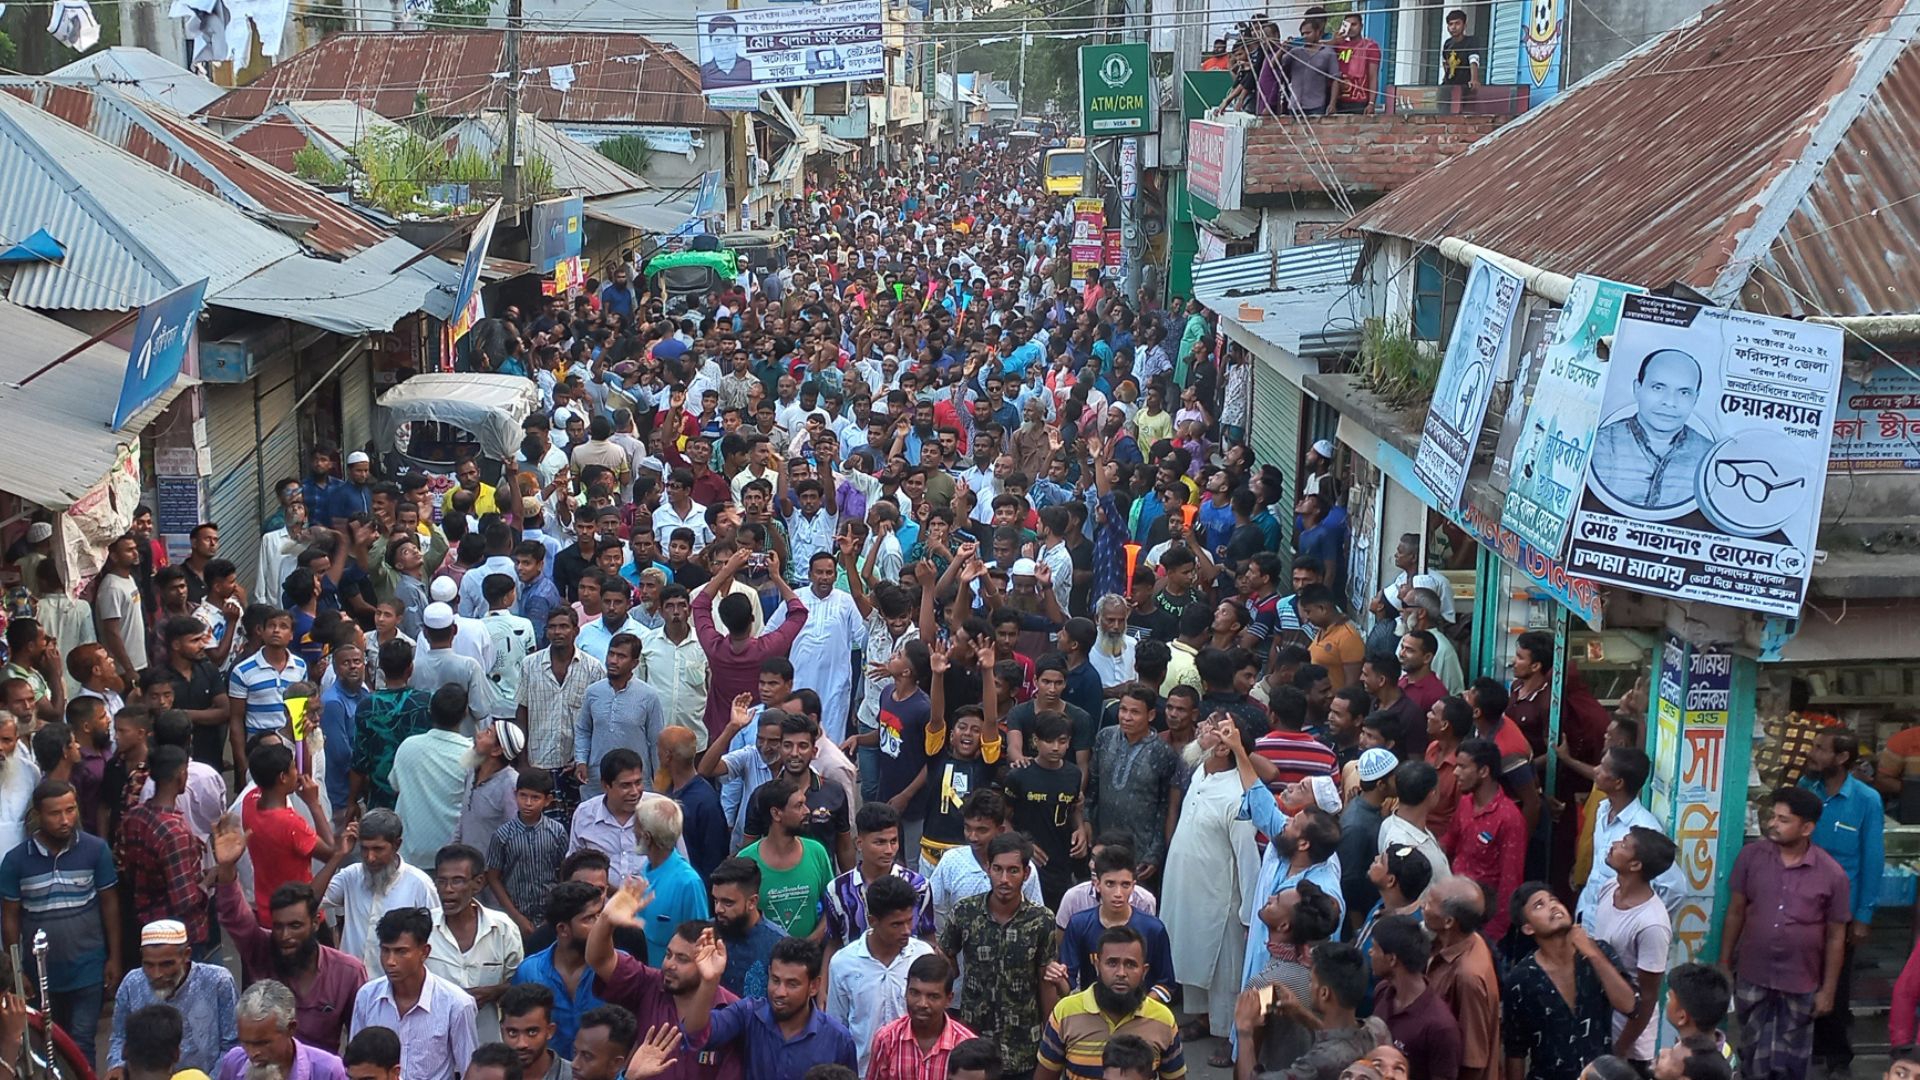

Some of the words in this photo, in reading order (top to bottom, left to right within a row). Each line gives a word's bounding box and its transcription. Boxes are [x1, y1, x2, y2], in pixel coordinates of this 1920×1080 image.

[750, 35, 774, 49] মোঃ
[1090, 94, 1143, 112] ATM/CRM
[1736, 335, 1749, 343] ১৭
[1751, 336, 1785, 351] অক্টোবর
[1787, 344, 1813, 355] ২০২২
[1816, 346, 1828, 358] ইং
[1771, 328, 1796, 340] আসন্ন
[1734, 346, 1789, 368] ফরিদপুর
[1794, 358, 1829, 374] জেলা
[1551, 357, 1564, 377] ১৬
[1564, 356, 1601, 390] ডিসেম্বর
[1749, 367, 1775, 380] পরিষদ
[1777, 369, 1808, 384] নির্বাচনে
[1726, 379, 1789, 398] জনপ্রতিনিধিদের
[1790, 387, 1826, 404] মনোনীত
[1720, 394, 1823, 427] চেয়ারম্যান
[1834, 418, 1868, 441] কা
[1581, 521, 1618, 542] মোঃ
[1625, 528, 1702, 556] শাহাদাৎ
[1709, 542, 1774, 569] হোসেন
[1781, 557, 1799, 568] -কে
[1574, 548, 1625, 575] চশমা
[1626, 556, 1686, 589] মার্কায়
[1704, 564, 1751, 579] আপনাদের
[1752, 571, 1786, 585] মূল্যবান
[1689, 574, 1711, 585] ভোট
[1712, 576, 1734, 589] দিয়ে
[1735, 581, 1767, 596] জয়যুক্ত
[1769, 586, 1796, 600] করুন
[1157, 592, 1183, 617] Every
[1689, 646, 1732, 677] সামিয়া
[1686, 681, 1730, 711] টেলিকম
[1693, 712, 1720, 724] এন্ড
[1027, 791, 1047, 803] Super
